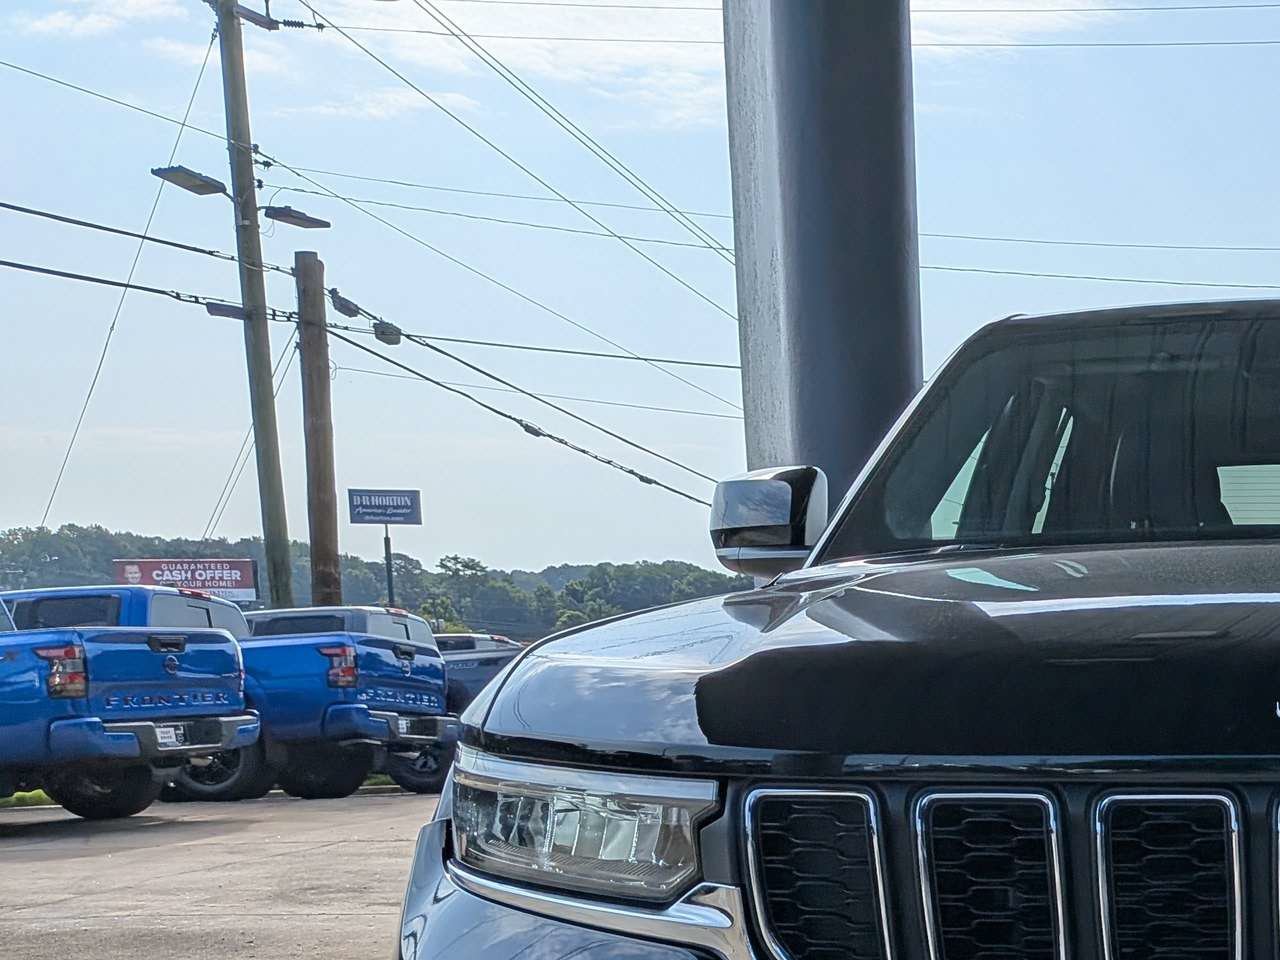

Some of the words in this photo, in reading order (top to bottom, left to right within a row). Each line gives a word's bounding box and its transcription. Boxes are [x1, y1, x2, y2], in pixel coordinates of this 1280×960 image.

[152, 570, 192, 580] CASH
[195, 570, 241, 581] OFFER
[105, 693, 229, 709] FRONTIER
